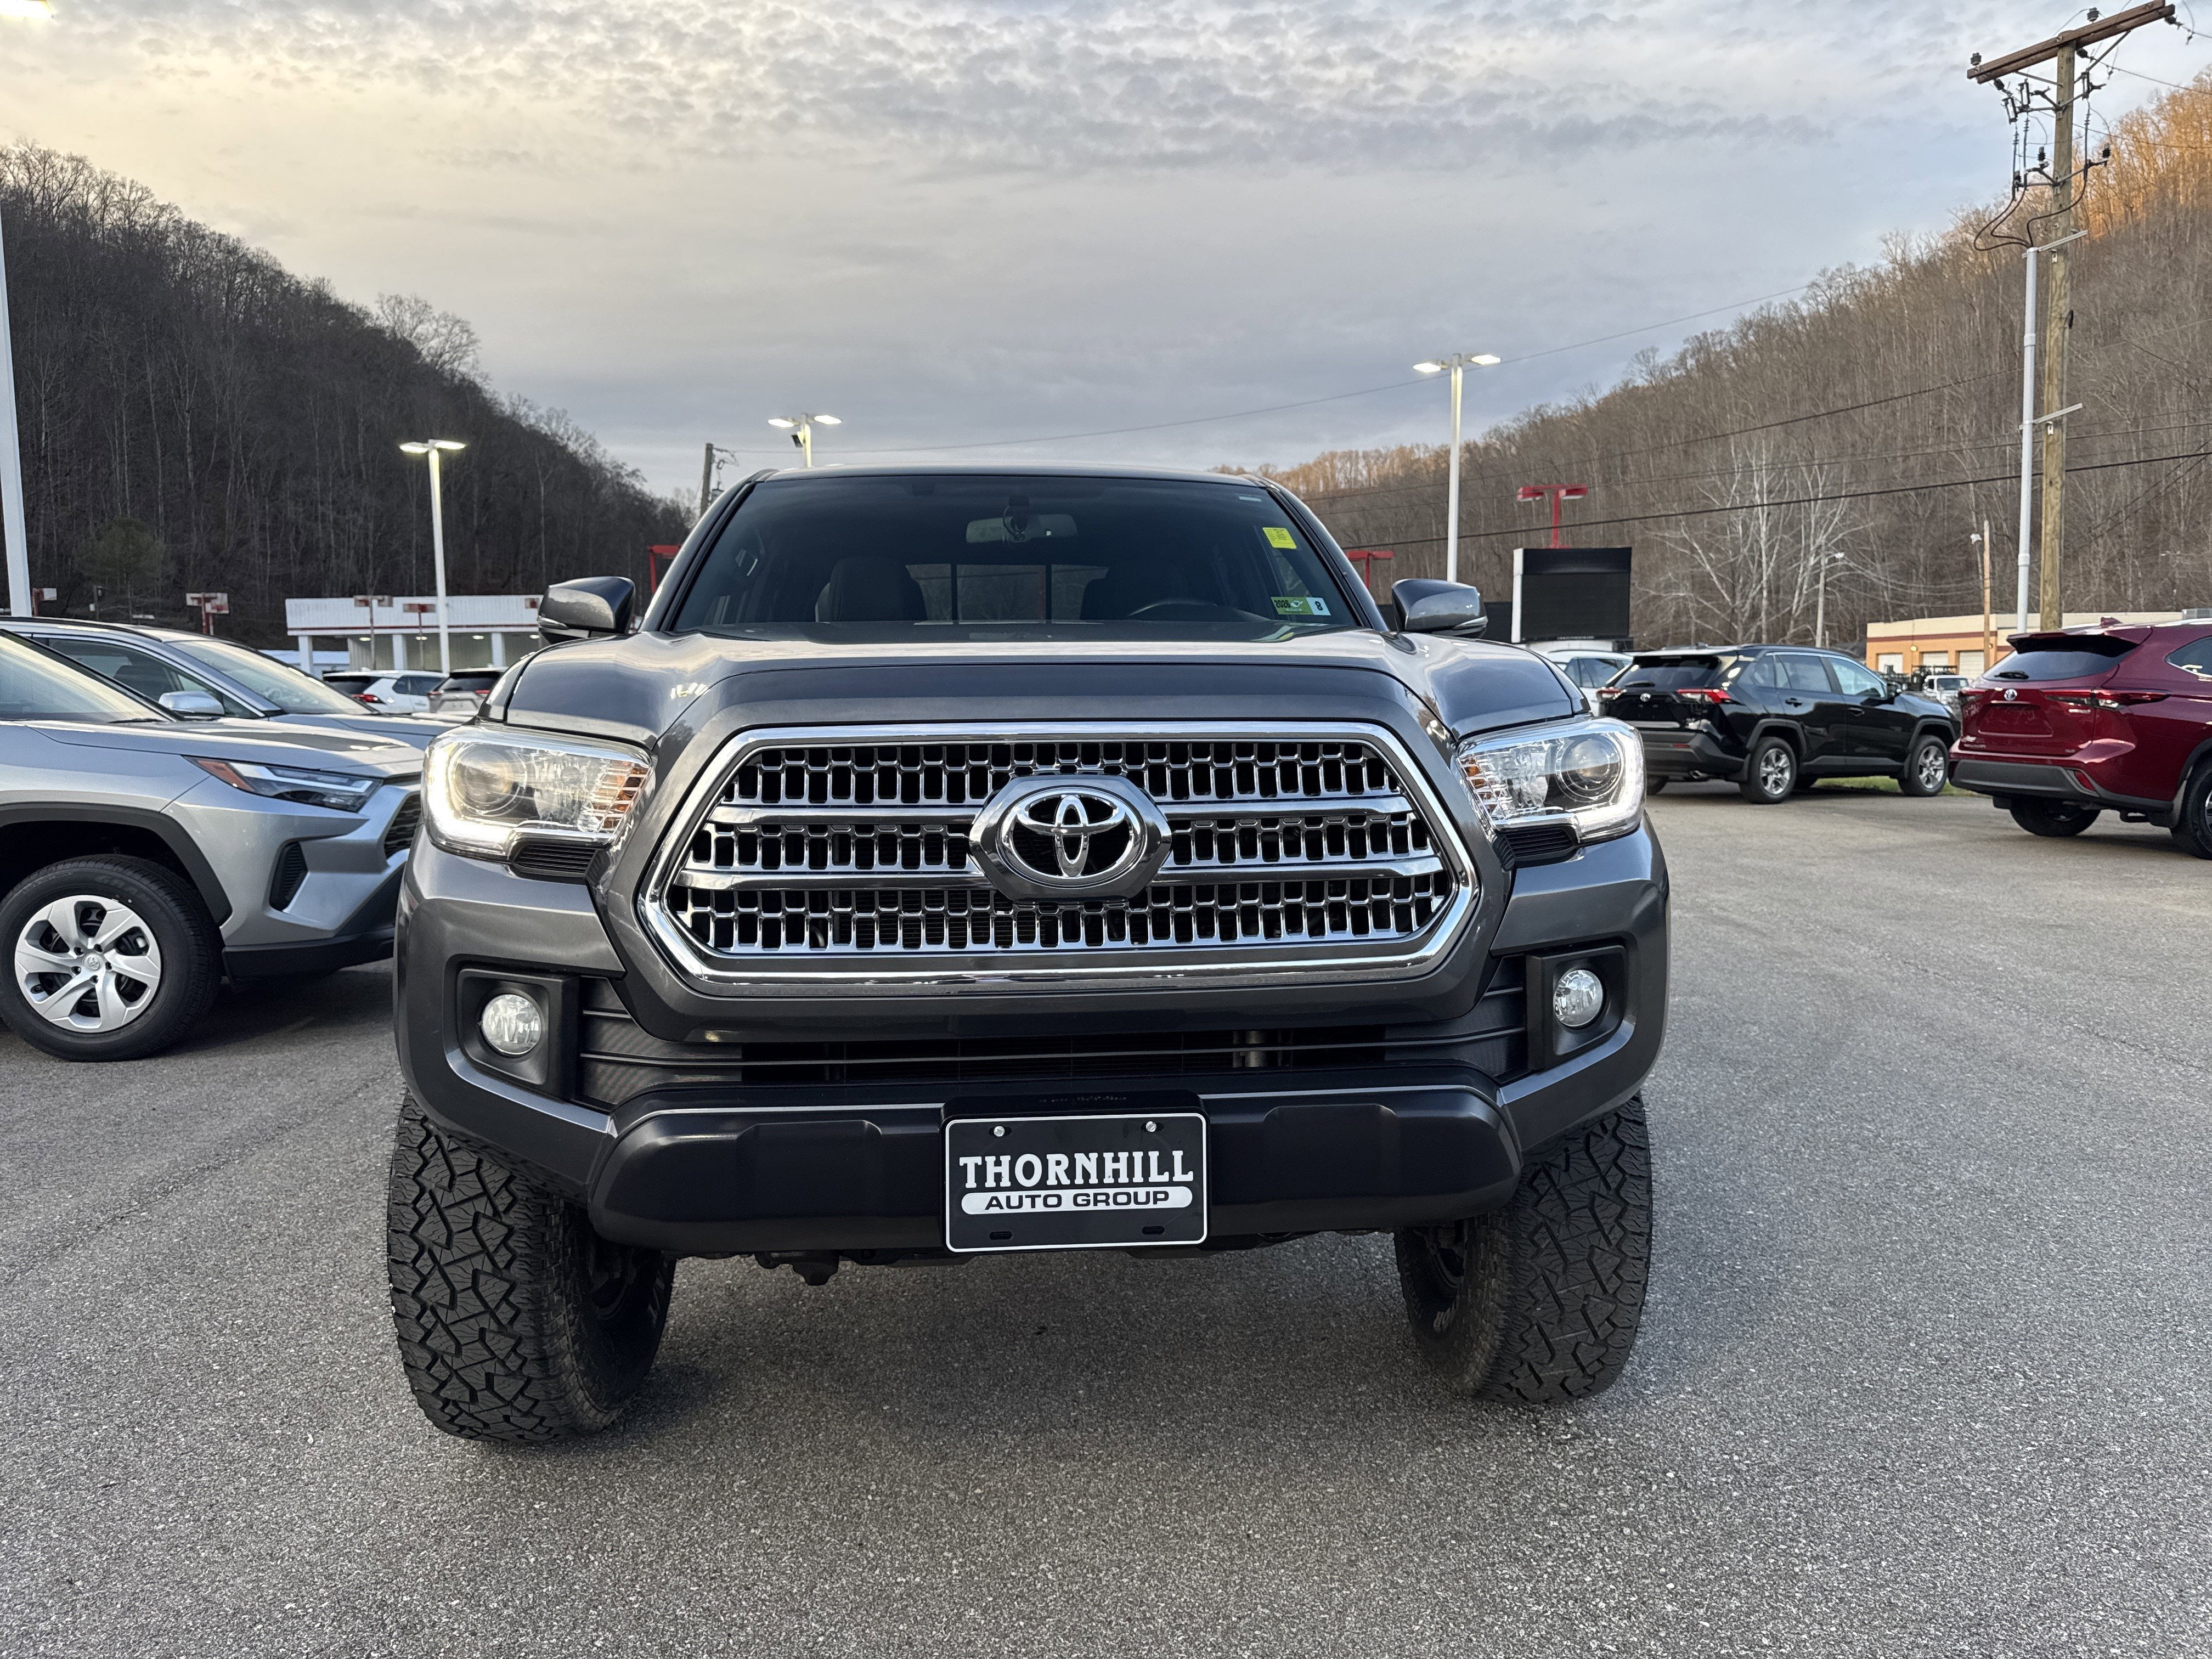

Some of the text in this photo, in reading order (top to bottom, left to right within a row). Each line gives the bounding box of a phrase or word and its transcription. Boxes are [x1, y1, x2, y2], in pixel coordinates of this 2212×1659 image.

[1314, 601, 1323, 611] 8
[959, 1150, 1193, 1188] THORNHILL
[984, 1190, 1169, 1210] AUTO GROUP
